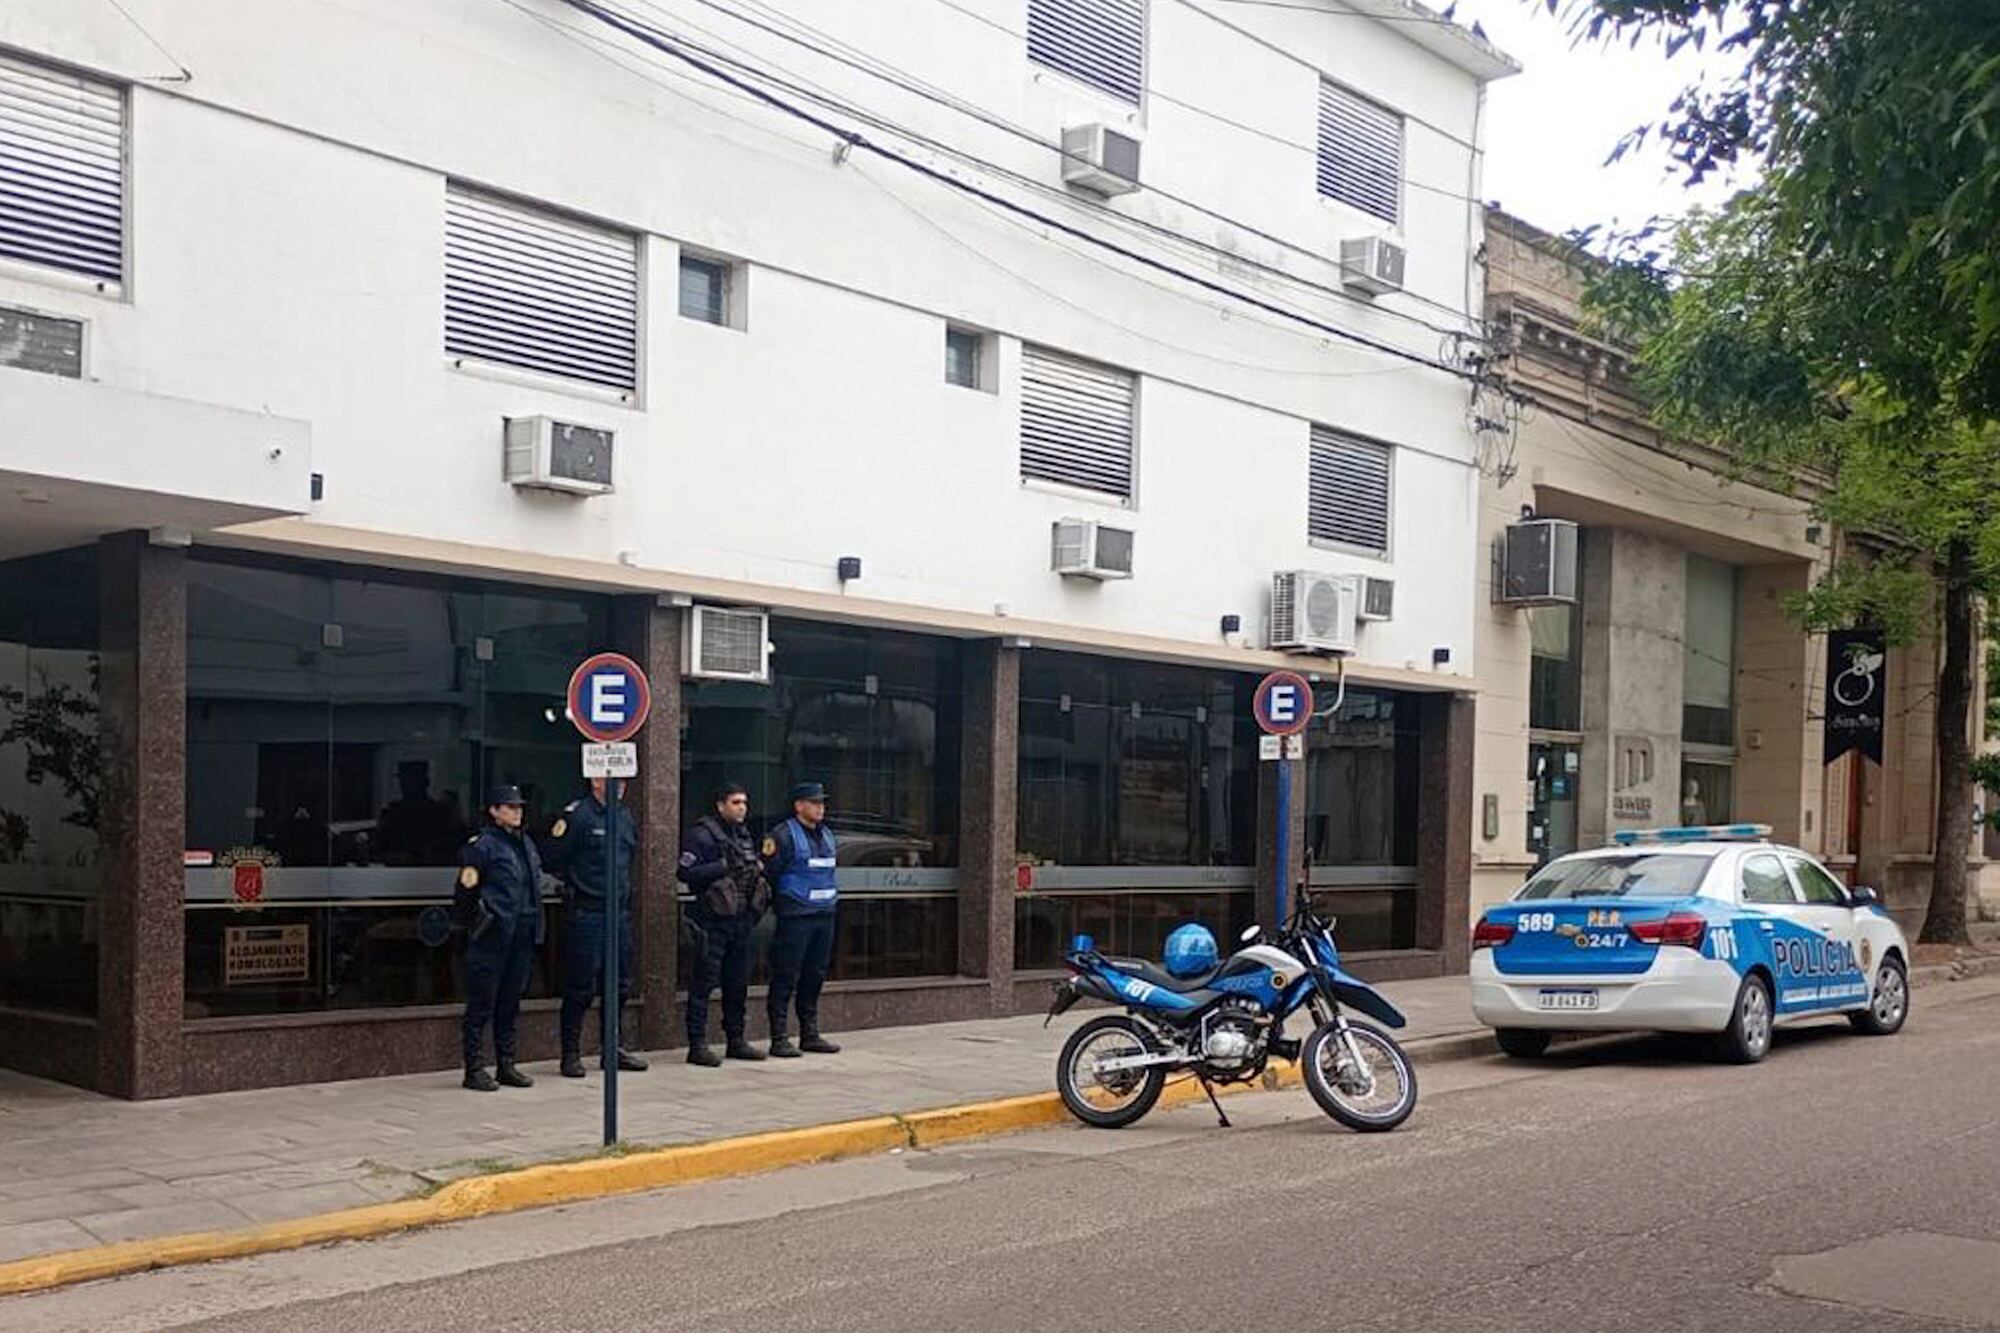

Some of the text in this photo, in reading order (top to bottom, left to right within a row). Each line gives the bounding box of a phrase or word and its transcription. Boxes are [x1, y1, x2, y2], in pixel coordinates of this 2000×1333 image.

[591, 674, 625, 722] E
[1271, 685, 1295, 720] E
[1517, 912, 1555, 933] 589
[1589, 933, 1629, 948] 24/7
[1710, 927, 1739, 961] 101
